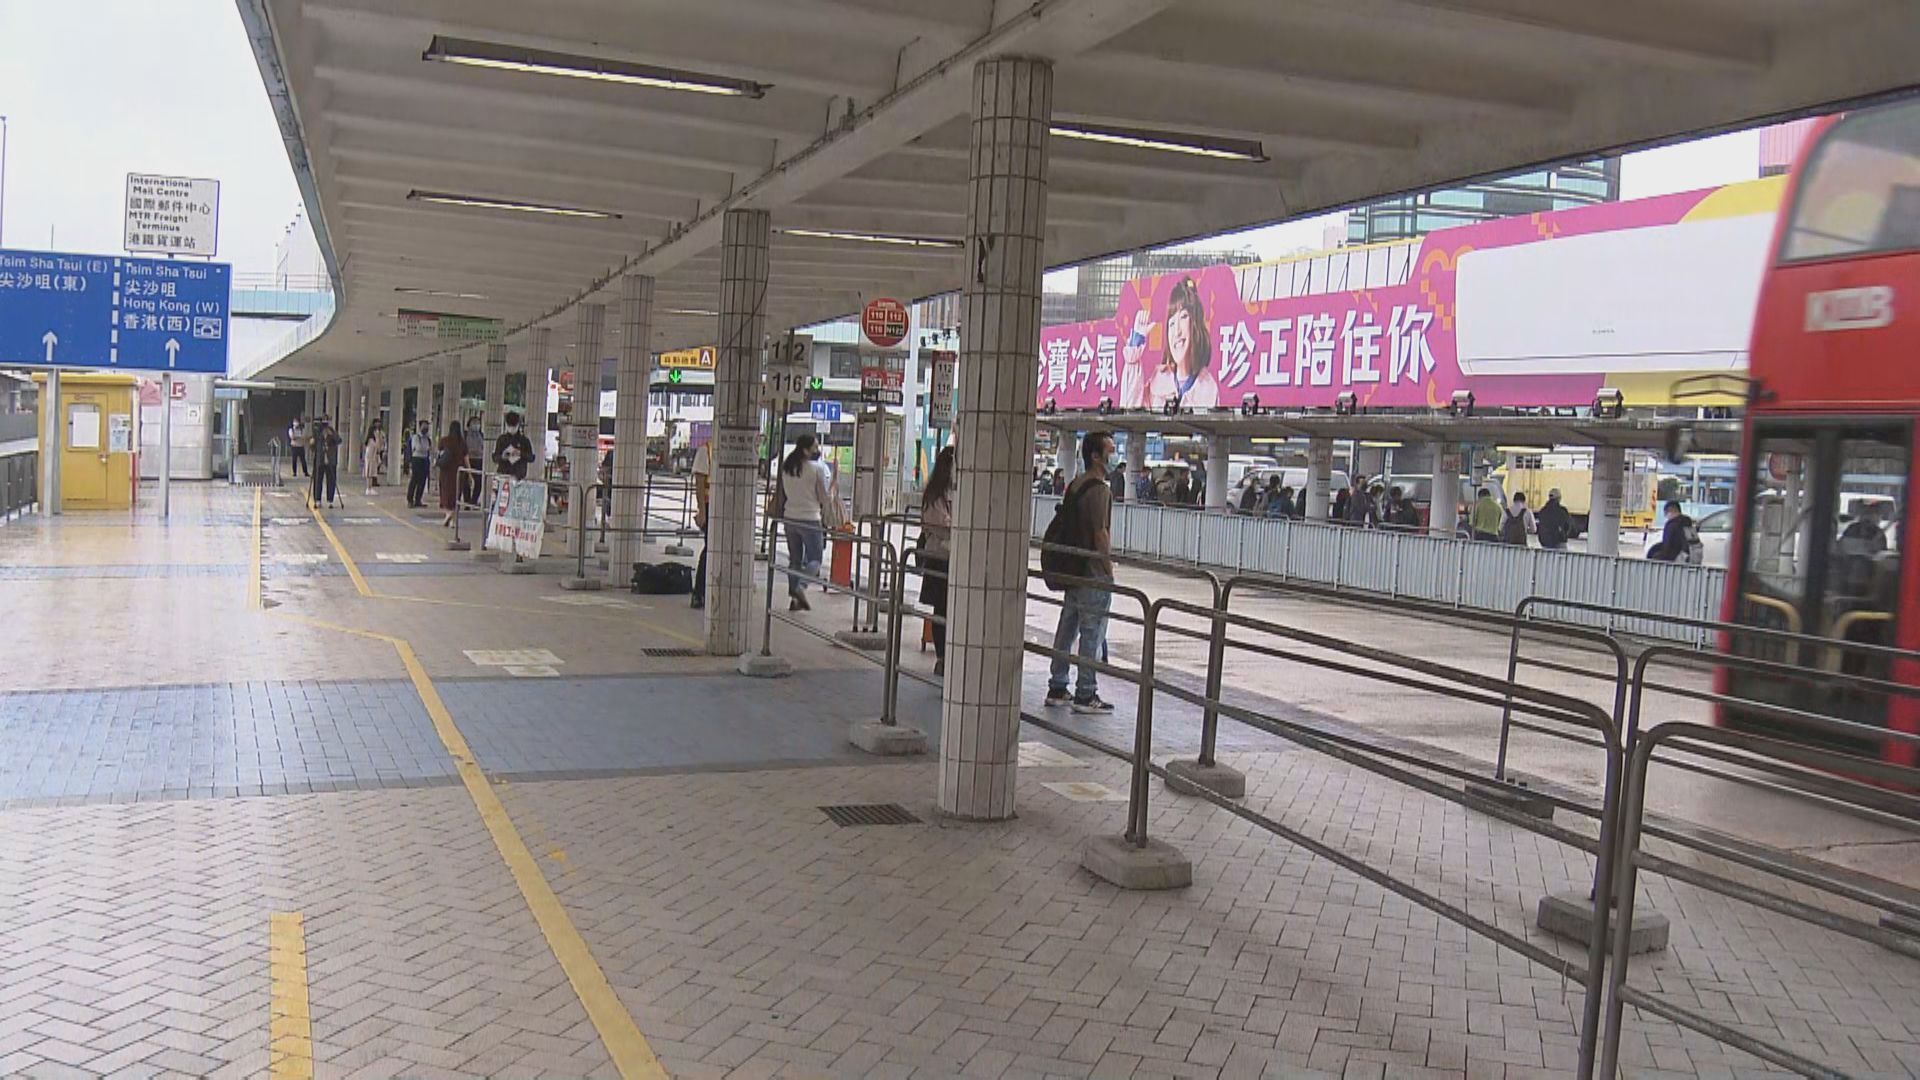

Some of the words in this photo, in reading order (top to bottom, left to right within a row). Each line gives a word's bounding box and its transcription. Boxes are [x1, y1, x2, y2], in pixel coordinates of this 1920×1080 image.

[130, 176, 192, 188] International
[133, 186, 154, 195] Mail
[156, 188, 189, 197] Centre
[129, 211, 151, 219] MTR
[154, 213, 188, 223] Freight
[136, 221, 180, 231] Terminus
[30, 256, 54, 269] Sha
[57, 258, 82, 271] Tsui
[86, 260, 108, 273] (E)
[125, 262, 152, 275] Tsim
[156, 264, 179, 277] Sha
[182, 266, 207, 279] Tsui
[125, 278, 176, 297] 尖沙咀
[123, 297, 155, 312] Hong
[159, 299, 190, 314] Kong
[196, 302, 219, 315] (W)
[124, 313, 190, 332] 香港(西)
[772, 341, 804, 361] 112
[1217, 304, 1437, 388] 珍正陪住你
[701, 350, 711, 365] A
[938, 364, 952, 373] 112
[772, 372, 803, 393] 116
